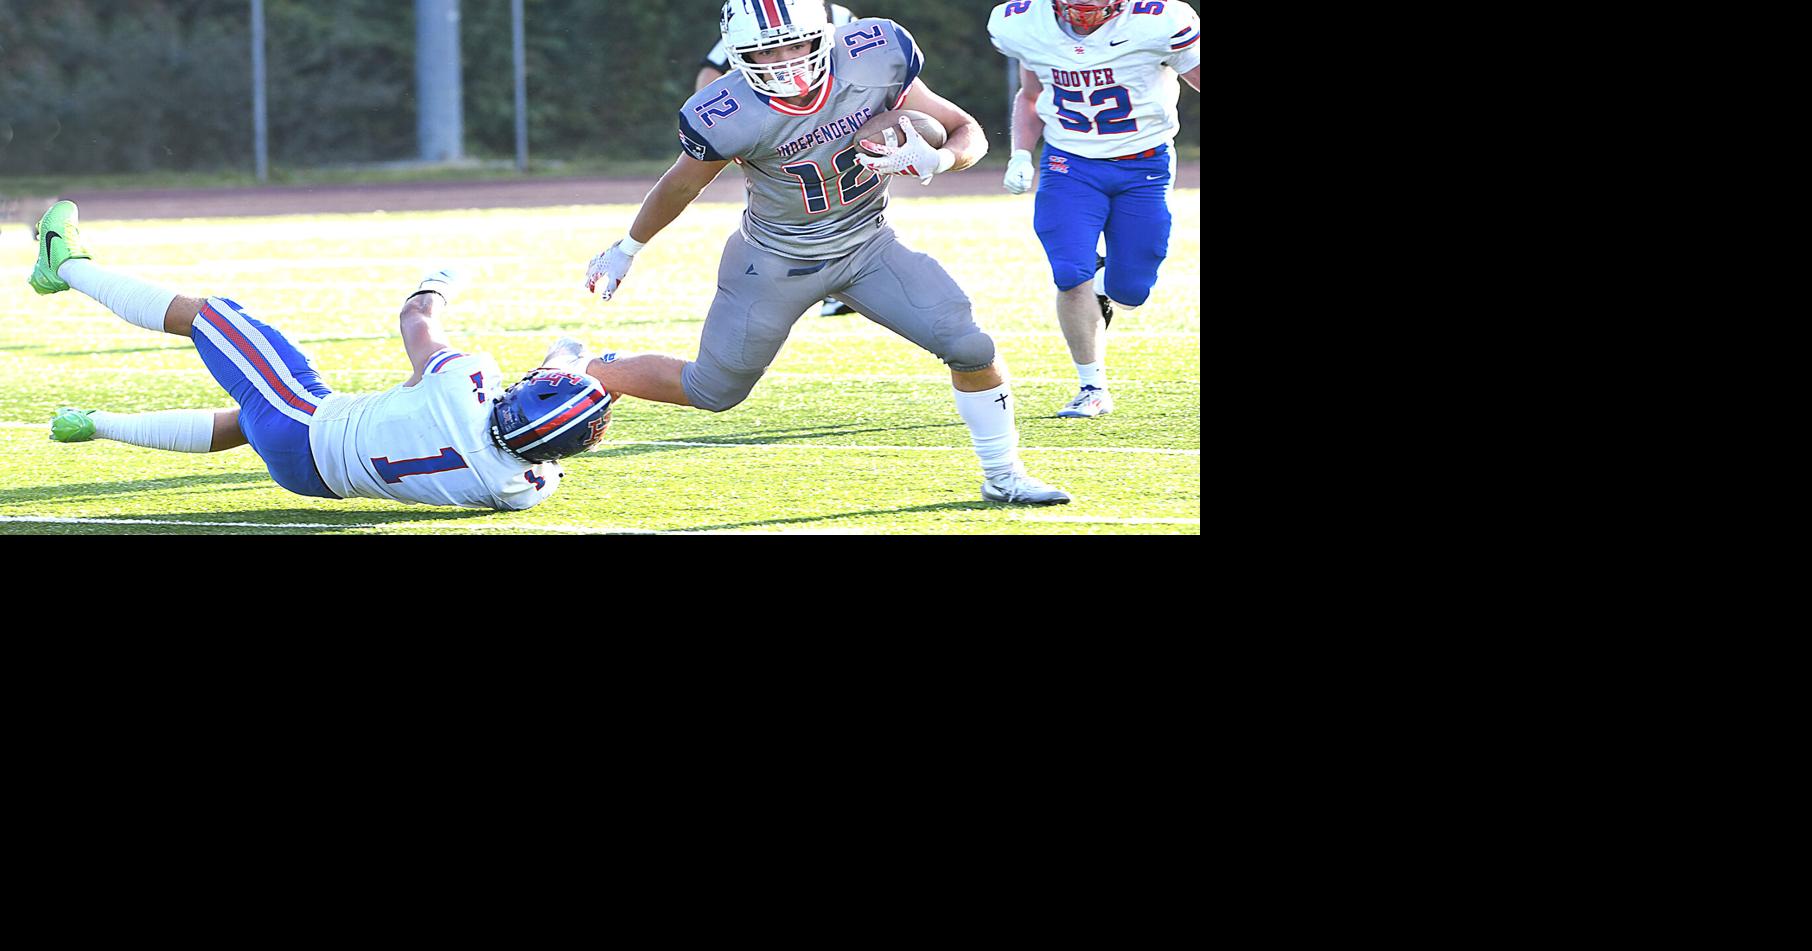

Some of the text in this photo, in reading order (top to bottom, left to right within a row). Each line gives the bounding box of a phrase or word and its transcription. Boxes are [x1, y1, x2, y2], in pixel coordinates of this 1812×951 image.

[843, 24, 888, 59] 12
[1051, 68, 1115, 87] HOOVER
[694, 88, 740, 128] 12
[1052, 84, 1138, 135] 52
[775, 107, 873, 157] INDEPENDENCE
[782, 144, 882, 214] 12
[371, 446, 469, 484] 1
